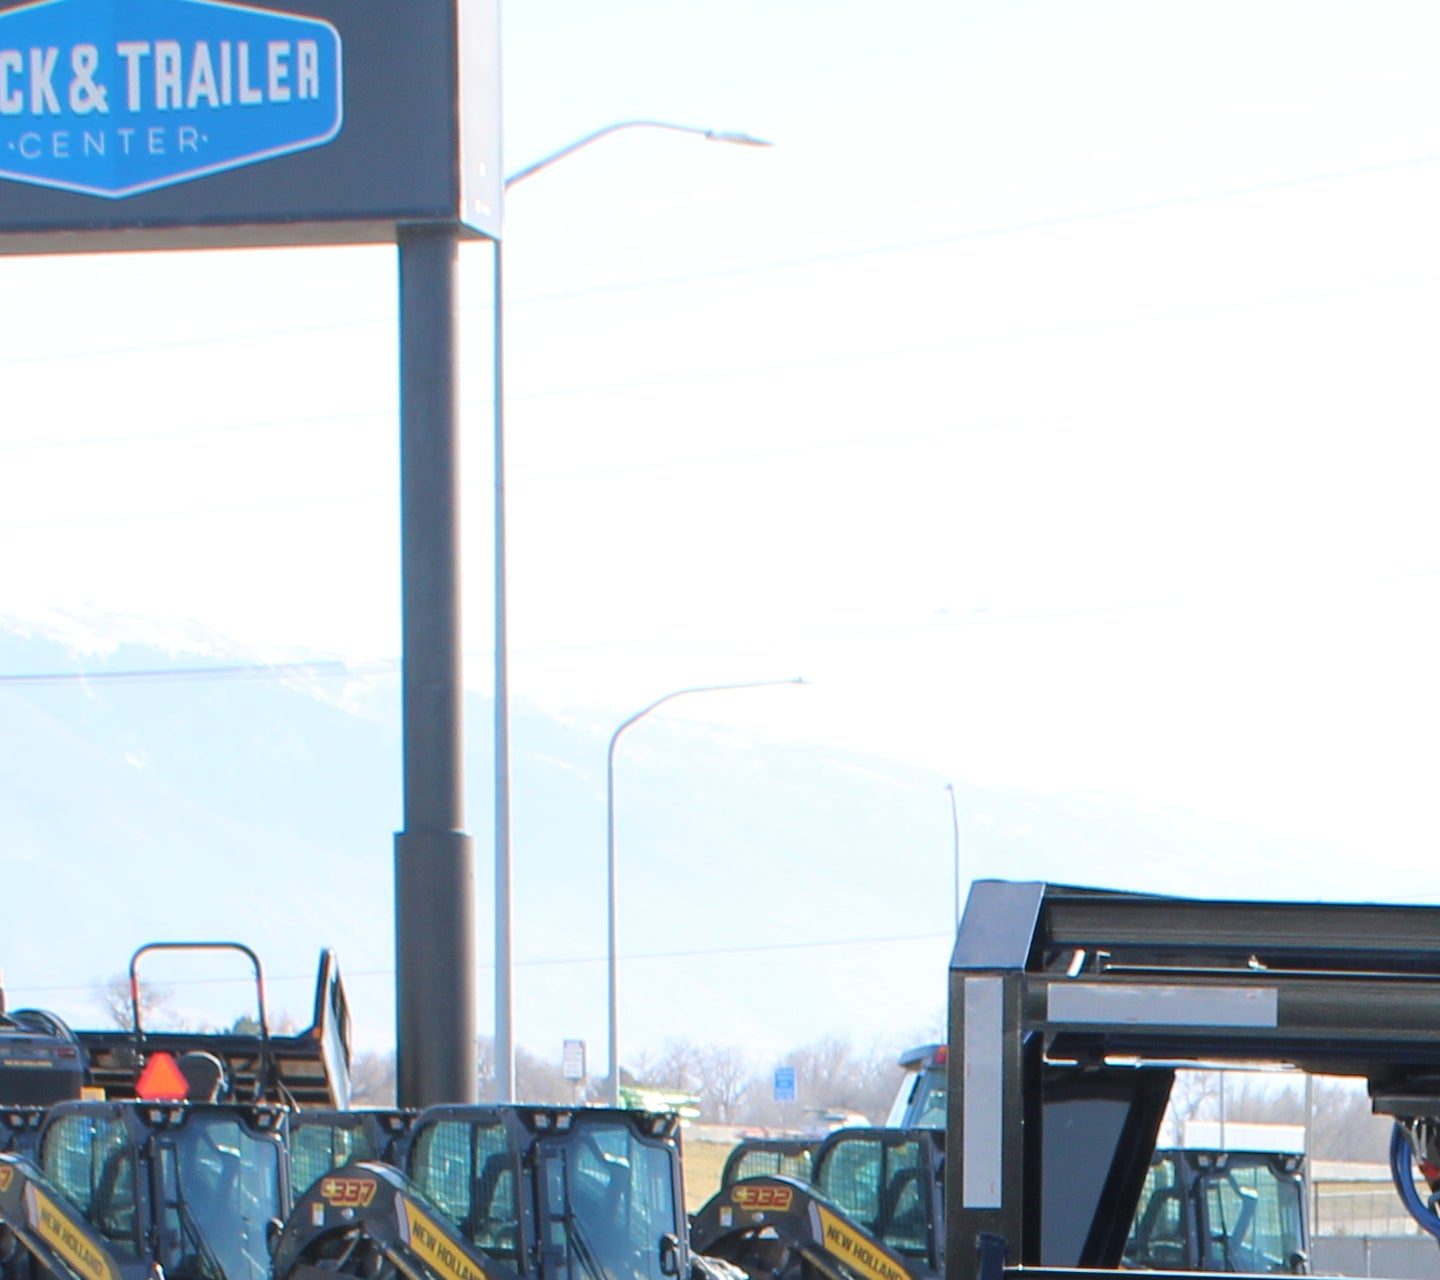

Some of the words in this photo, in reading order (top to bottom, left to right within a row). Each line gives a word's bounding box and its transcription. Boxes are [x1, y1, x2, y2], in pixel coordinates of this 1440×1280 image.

[69, 43, 110, 116] &
[116, 39, 320, 114] TRAILER
[18, 126, 200, 160] CENTER
[61, 1222, 104, 1277] HOLLAND
[412, 1220, 438, 1253] NEW
[826, 1223, 854, 1254] NEW
